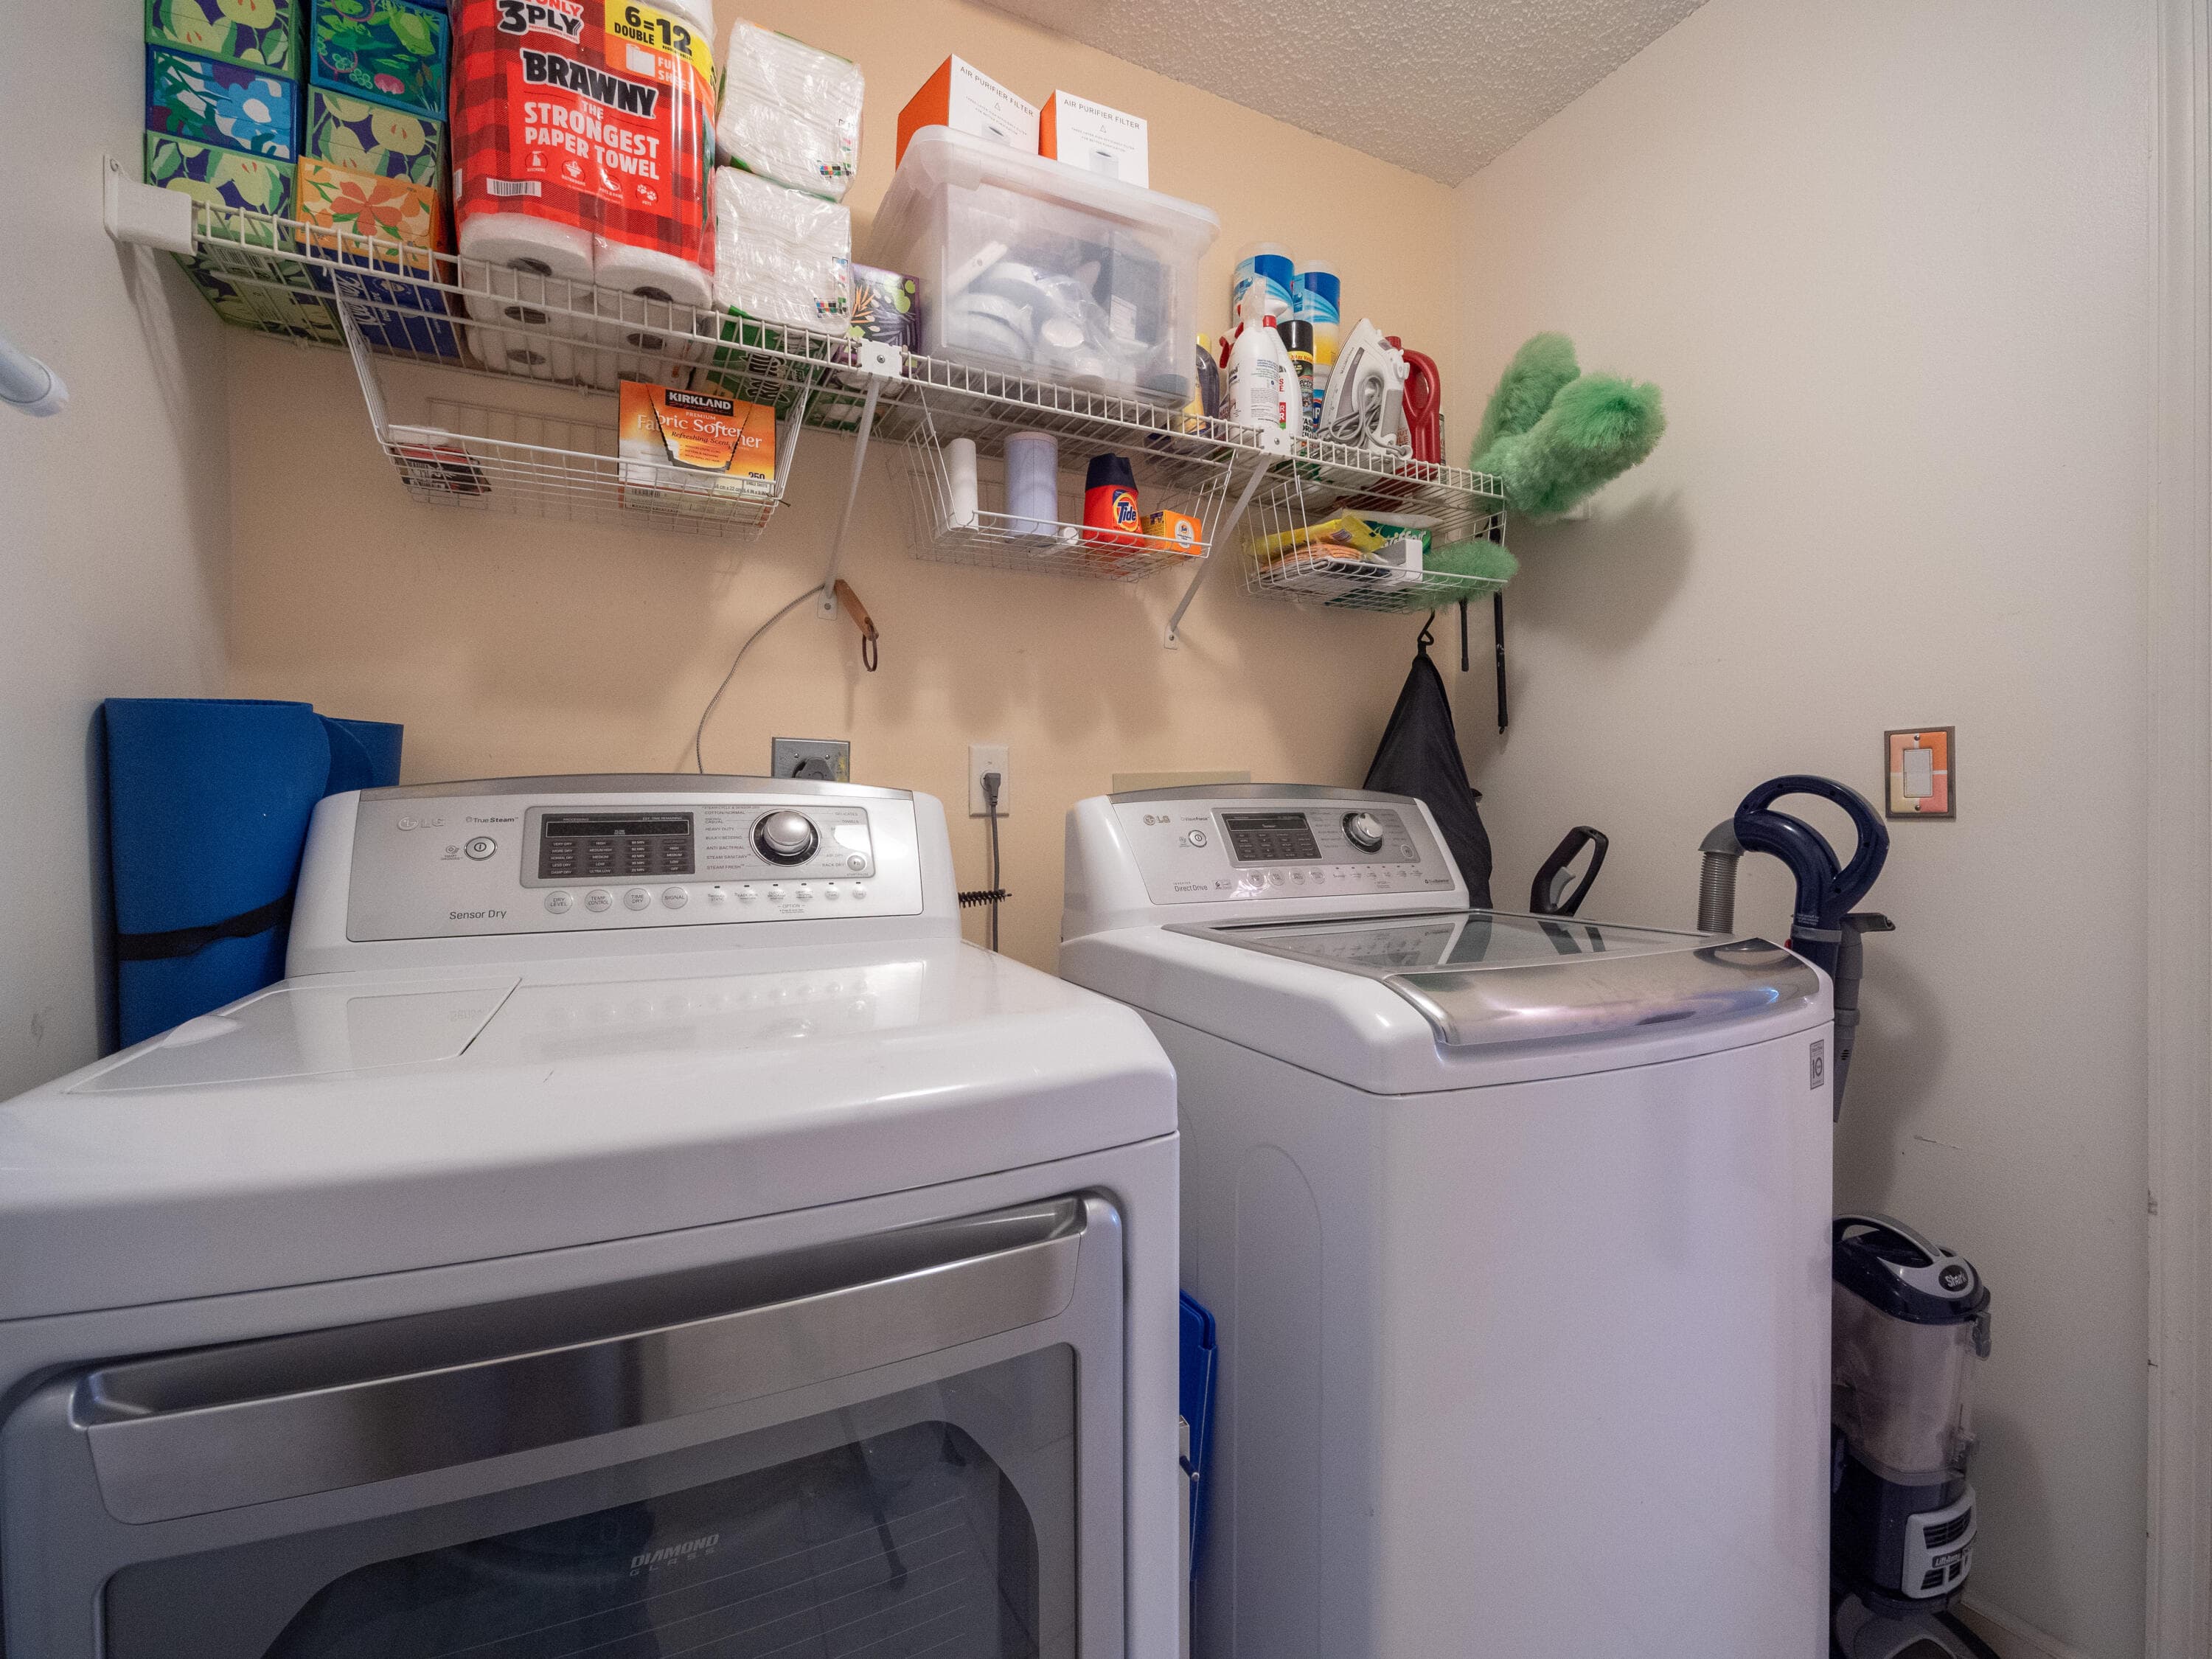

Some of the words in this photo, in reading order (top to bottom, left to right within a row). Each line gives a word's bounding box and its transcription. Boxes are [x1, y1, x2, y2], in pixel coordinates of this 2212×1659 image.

[614, 22, 654, 46] DOUBLE
[522, 49, 658, 118] BRAWNY
[960, 66, 973, 78] AIR
[975, 75, 1008, 100] PURIFIER
[1010, 97, 1034, 117] FILTER
[581, 100, 604, 121] THE
[1064, 99, 1077, 108] AIR
[1079, 104, 1113, 121] PURIFIER
[1115, 116, 1140, 130] FILTER
[524, 101, 660, 159] STRONGEST
[525, 126, 589, 159] PAPER
[594, 145, 660, 180] TOWEL
[669, 392, 732, 411] KIRKLAND
[686, 411, 716, 421] PREMIUM
[636, 409, 689, 431] Fabric
[693, 417, 762, 448] Softener
[672, 431, 709, 444] Refreshing
[710, 437, 728, 447] Scent
[1116, 501, 1137, 525] Tide
[1157, 815, 1171, 824] LG
[1174, 884, 1193, 892] Direct
[1192, 883, 1208, 891] Drive
[449, 911, 485, 920] Sensor
[487, 909, 507, 919] Dry
[1945, 1270, 1967, 1287] Shark
[630, 1534, 720, 1569] DIAMOND
